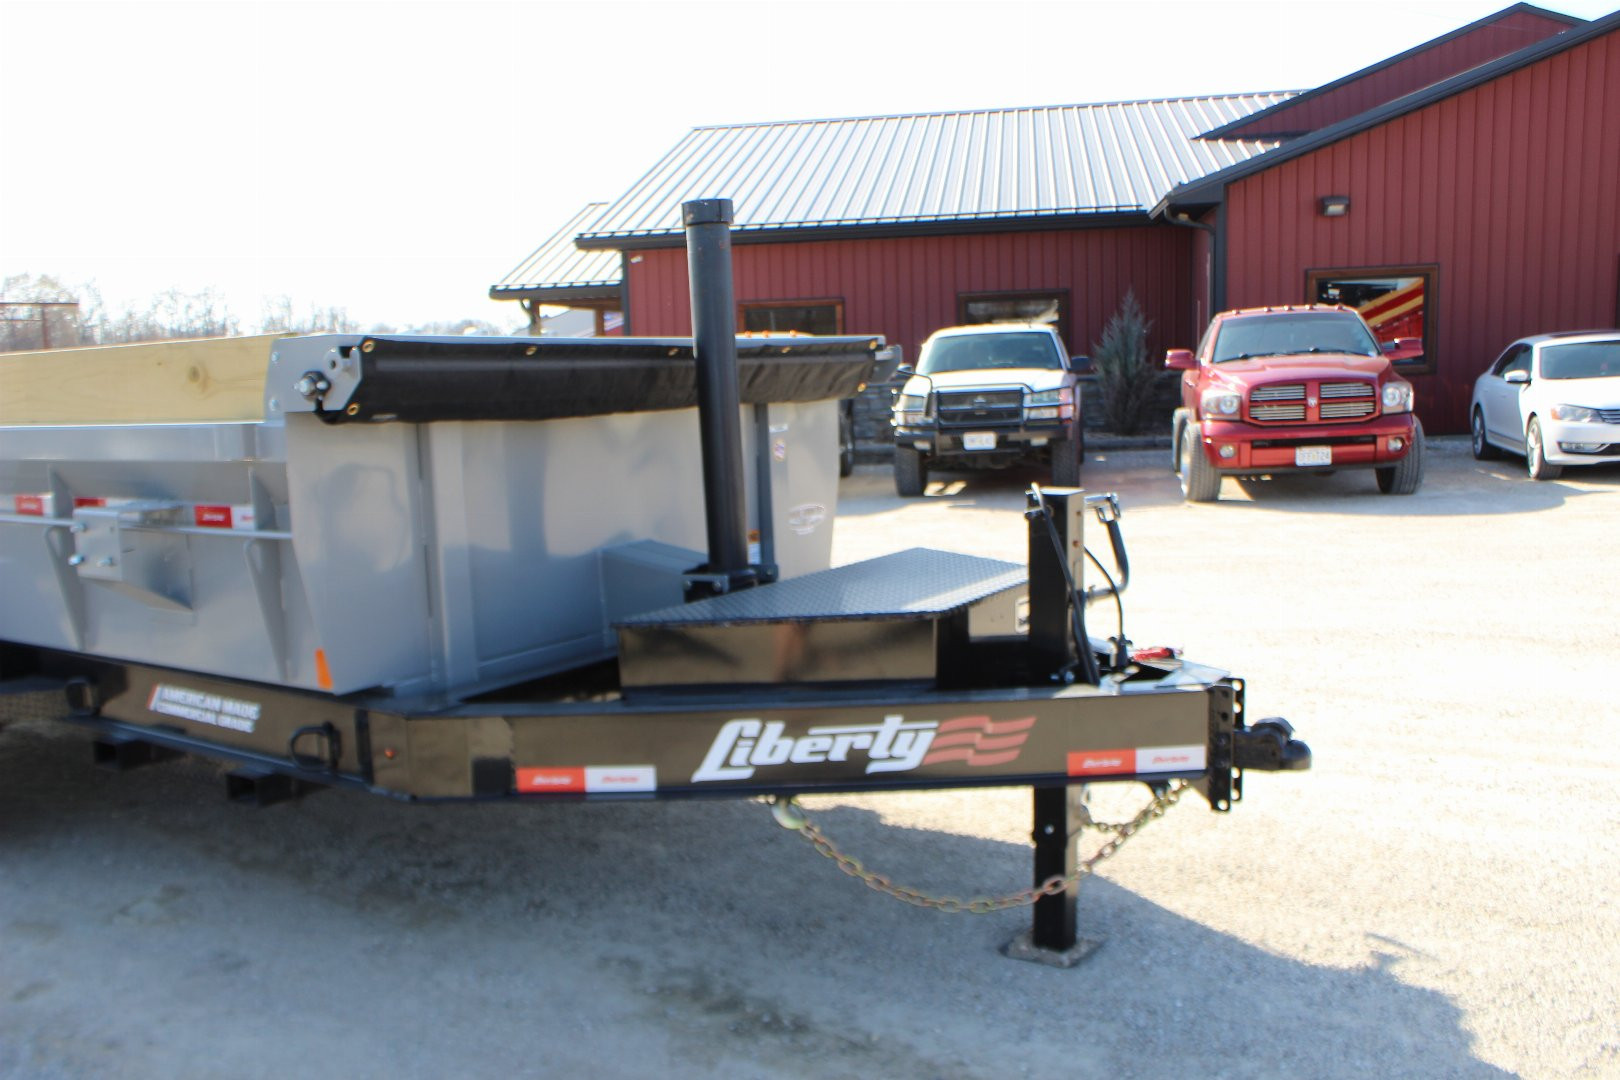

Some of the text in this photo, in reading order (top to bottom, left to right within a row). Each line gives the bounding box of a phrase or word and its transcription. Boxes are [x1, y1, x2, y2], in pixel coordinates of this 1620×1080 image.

[160, 683, 261, 721] AMERICAN MADE
[690, 714, 939, 783] Liberty
